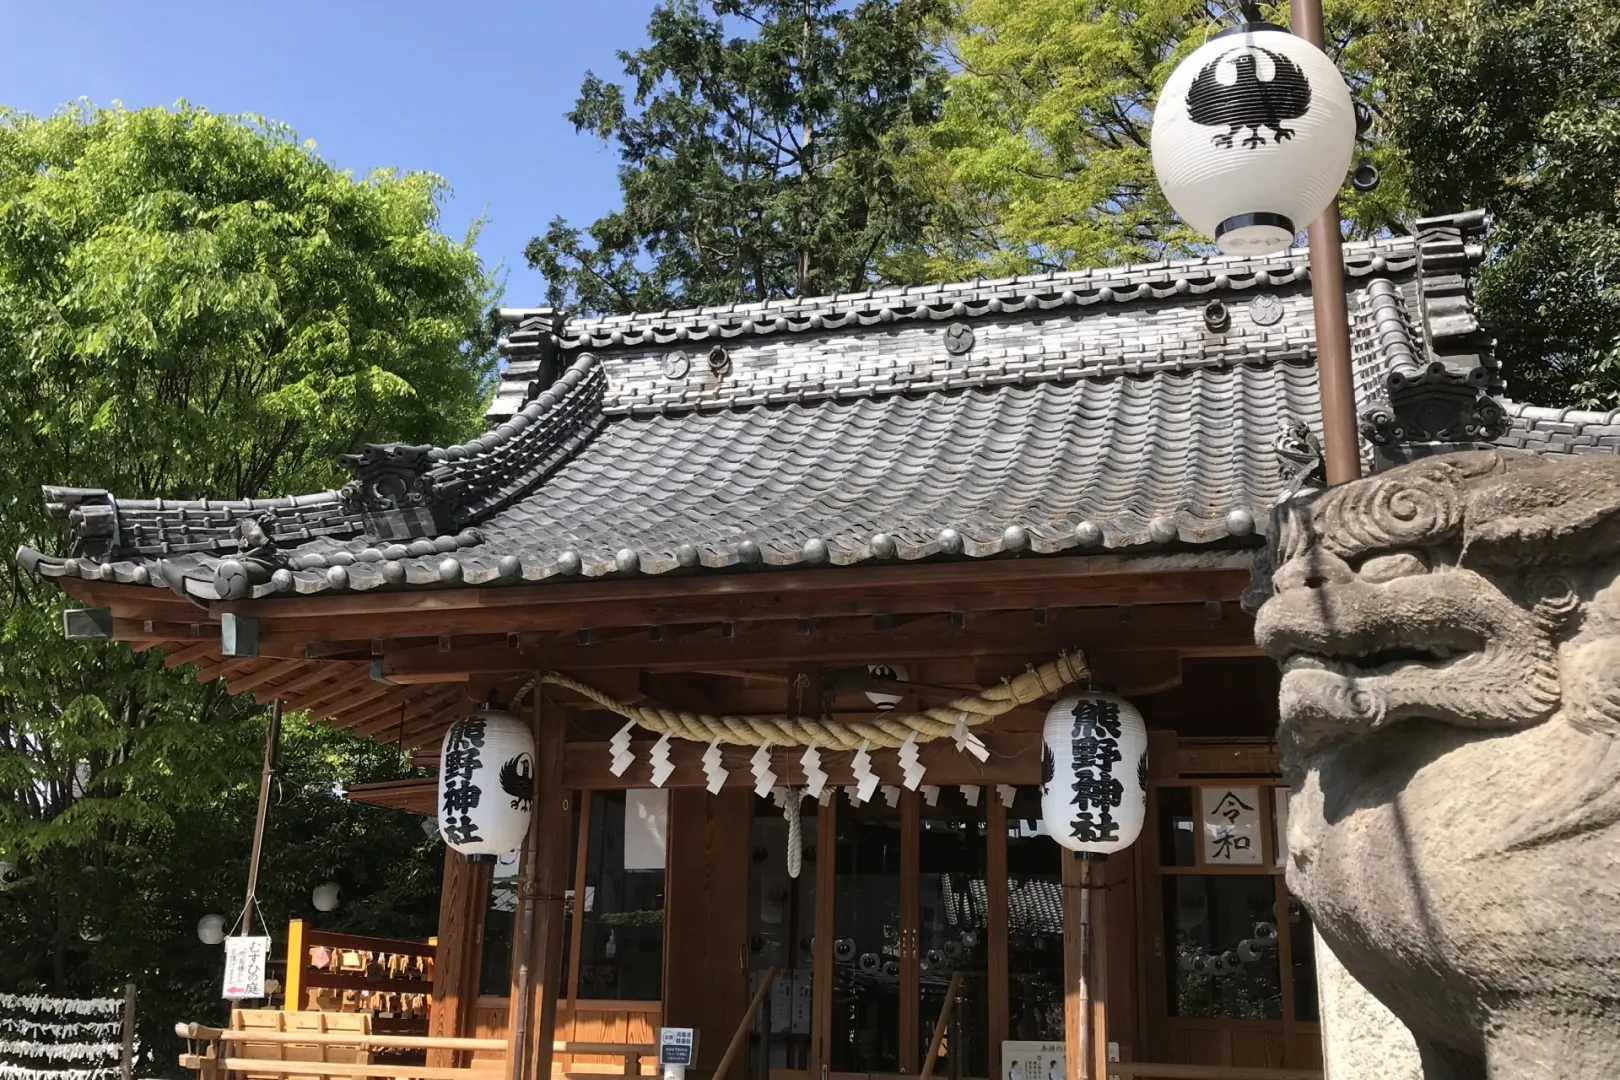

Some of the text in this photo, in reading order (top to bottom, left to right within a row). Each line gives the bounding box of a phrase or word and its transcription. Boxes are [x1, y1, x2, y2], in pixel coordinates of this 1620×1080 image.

[442, 715, 487, 846] 熊野神社
[1069, 699, 1124, 842] 熊野神社
[1211, 791, 1255, 859] 令和
[244, 941, 261, 994] むすひの庭
